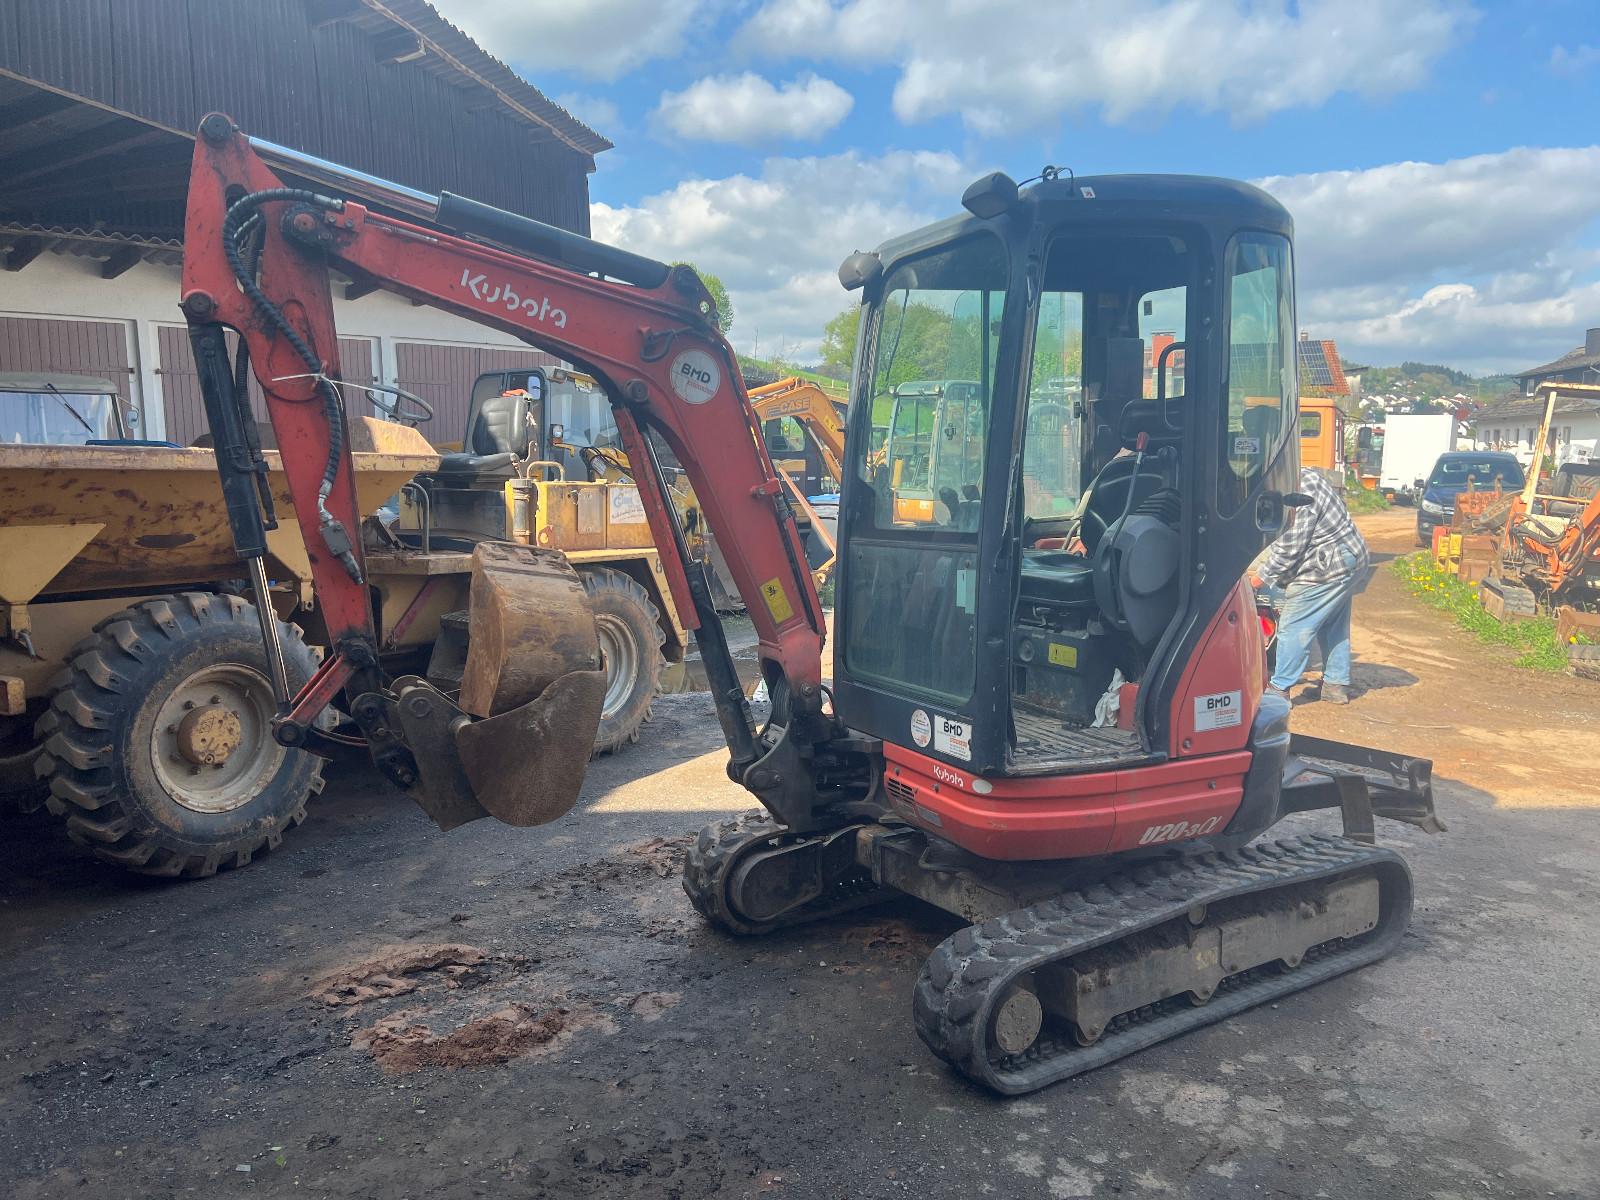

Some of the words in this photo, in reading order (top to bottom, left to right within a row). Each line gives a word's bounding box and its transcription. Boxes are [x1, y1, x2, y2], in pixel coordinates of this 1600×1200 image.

[460, 268, 567, 329] Kubota
[681, 363, 711, 384] BMD
[781, 397, 811, 412] CASE
[1207, 695, 1231, 709] BMD
[943, 721, 963, 737] BMD
[933, 765, 964, 788] Kubota
